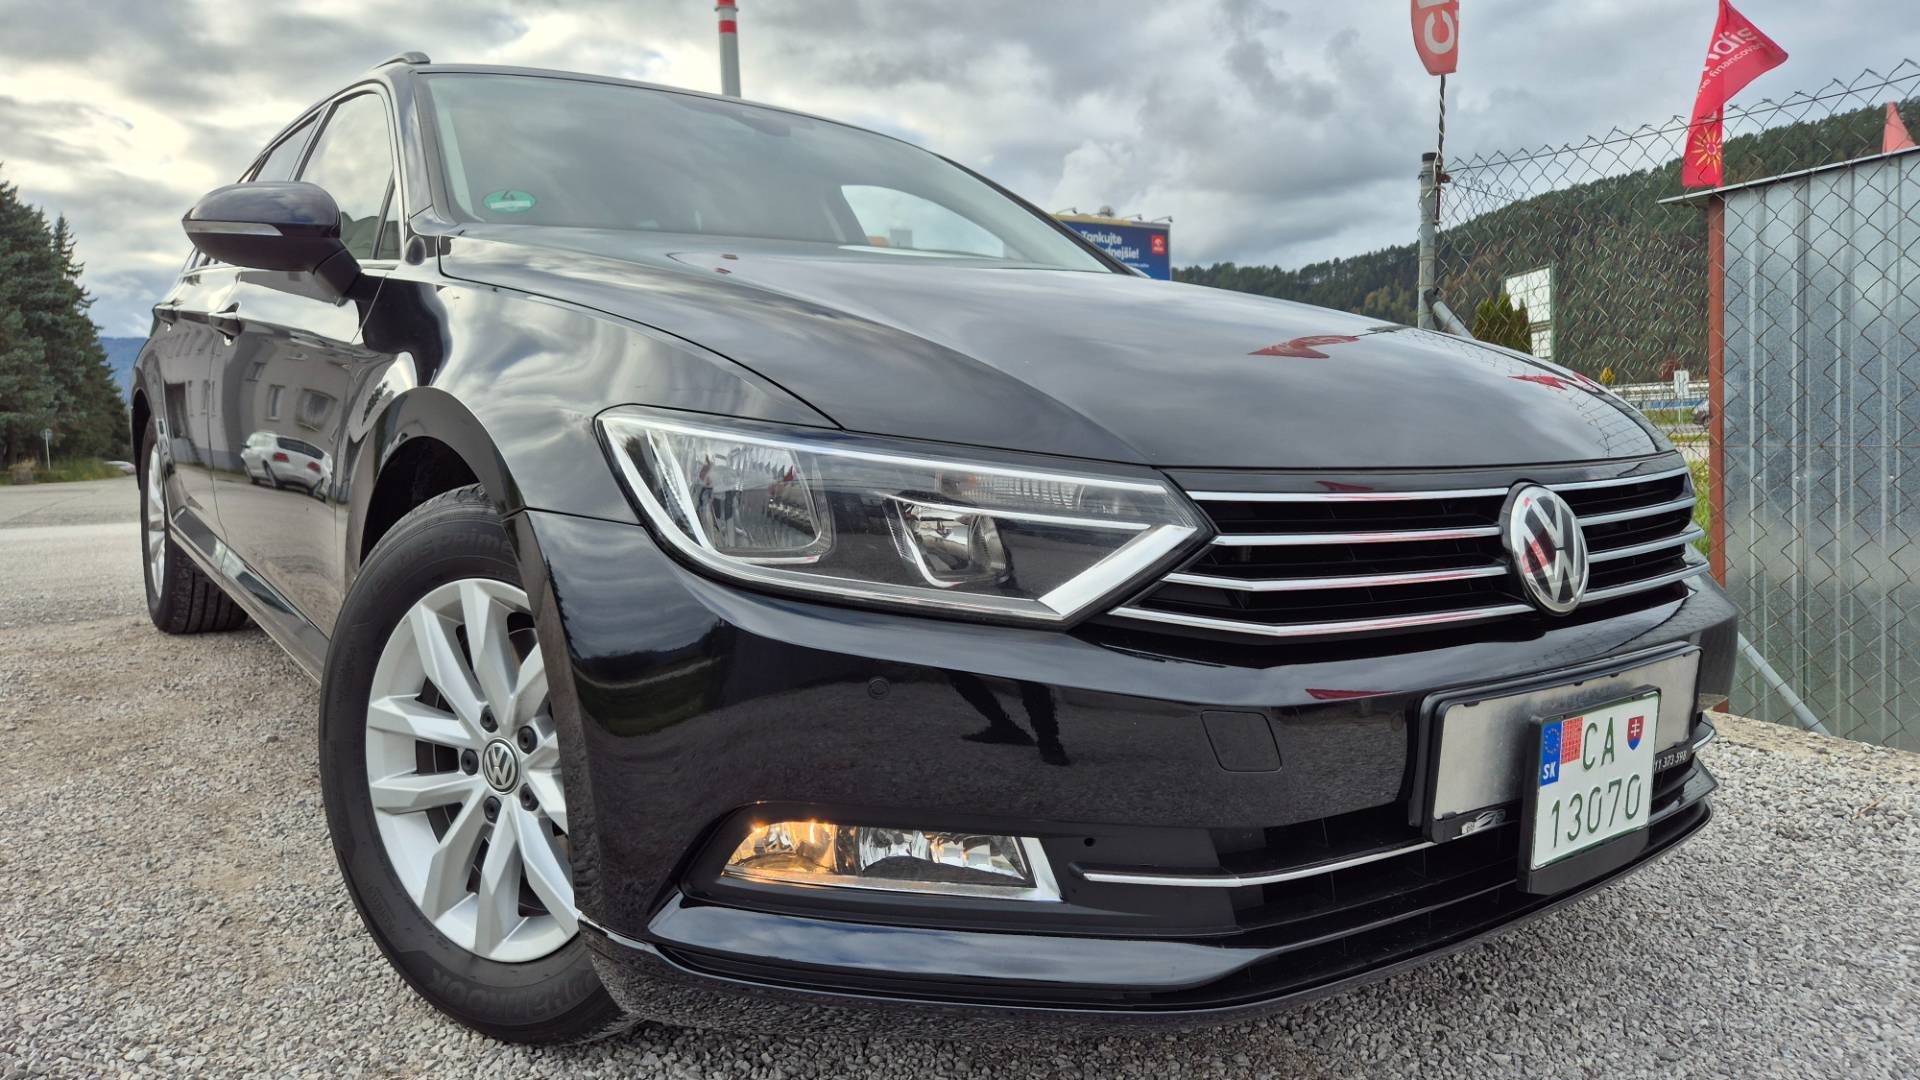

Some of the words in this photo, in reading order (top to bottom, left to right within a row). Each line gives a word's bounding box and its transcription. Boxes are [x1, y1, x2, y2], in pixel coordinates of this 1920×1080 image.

[1104, 245, 1139, 260] dnejšie!
[1582, 716, 1615, 771] CA
[1542, 761, 1557, 780] SK
[1551, 774, 1642, 849] 13070
